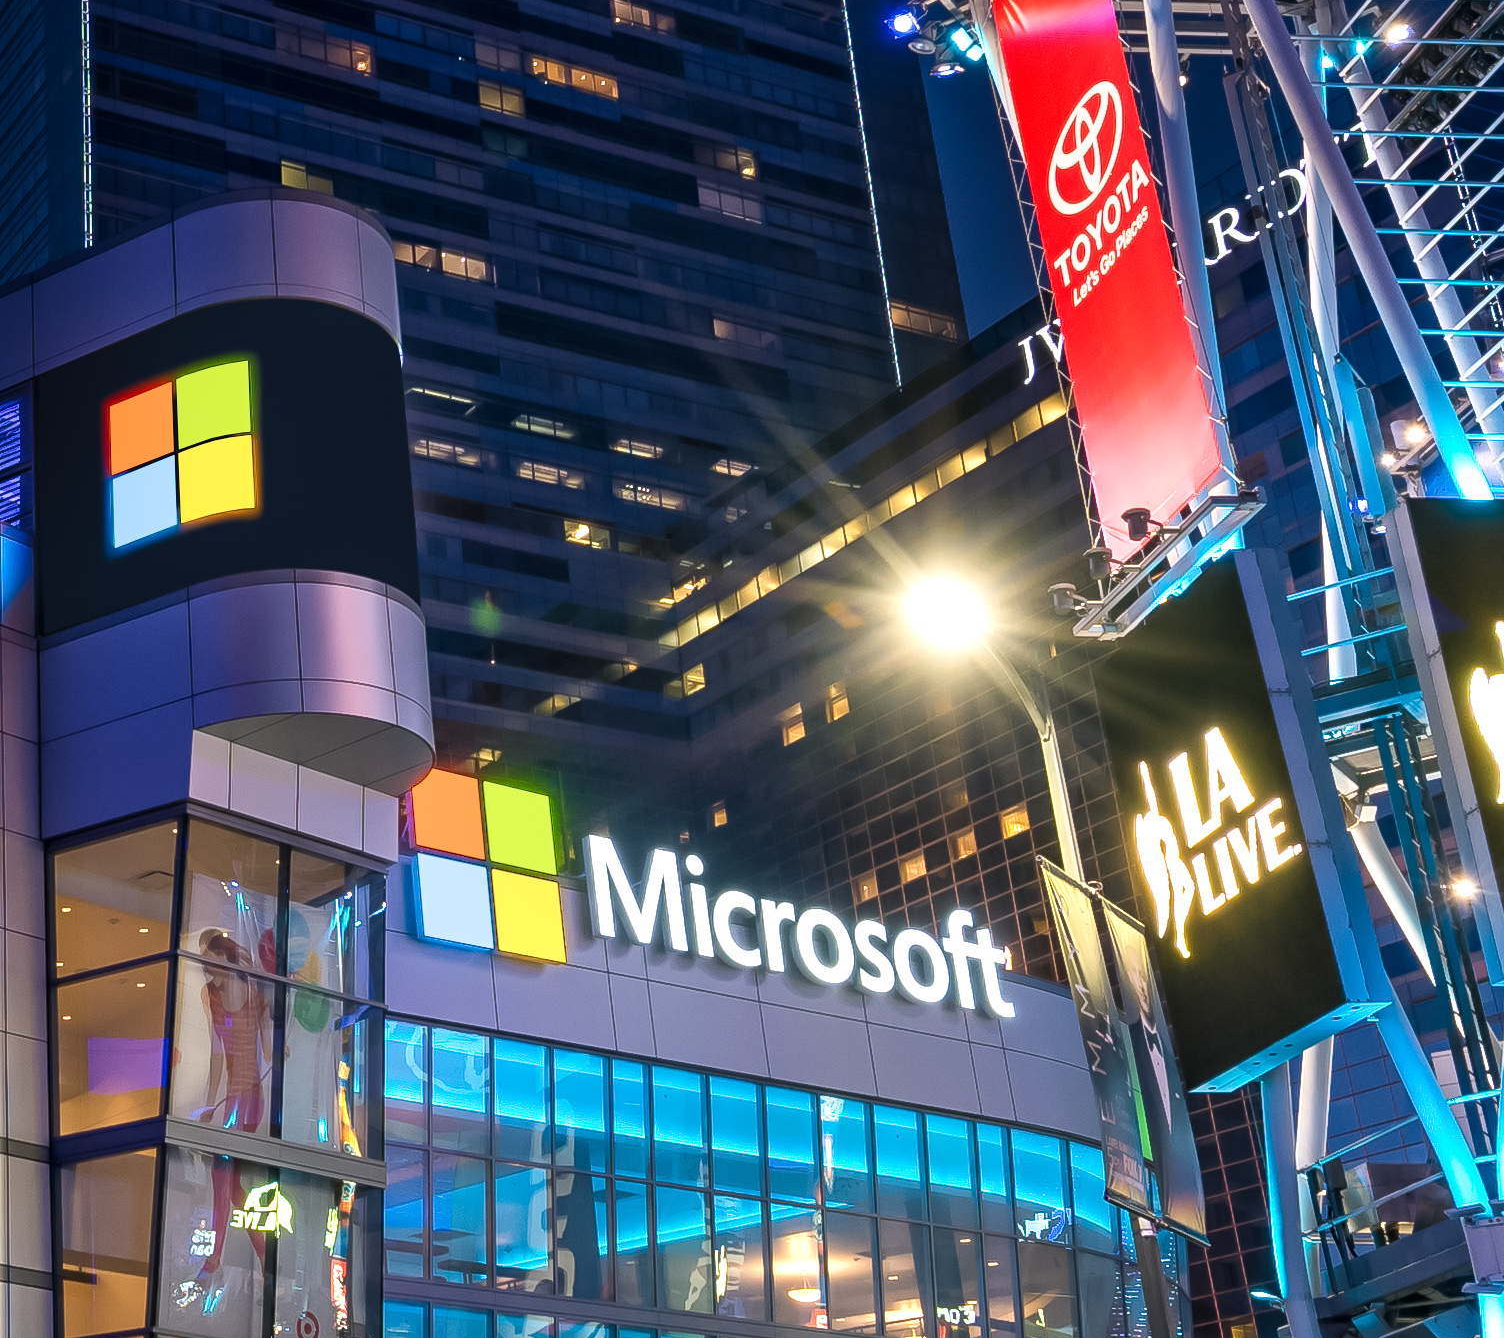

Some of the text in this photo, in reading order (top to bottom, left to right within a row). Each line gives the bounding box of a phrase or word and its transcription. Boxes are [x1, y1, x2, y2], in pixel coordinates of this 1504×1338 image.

[1054, 159, 1150, 288] TOYOTA
[1073, 206, 1149, 307] Let's Go Places
[1168, 726, 1256, 849] LA
[1191, 796, 1295, 917] LIVE
[581, 834, 1018, 1019] Microsoft
